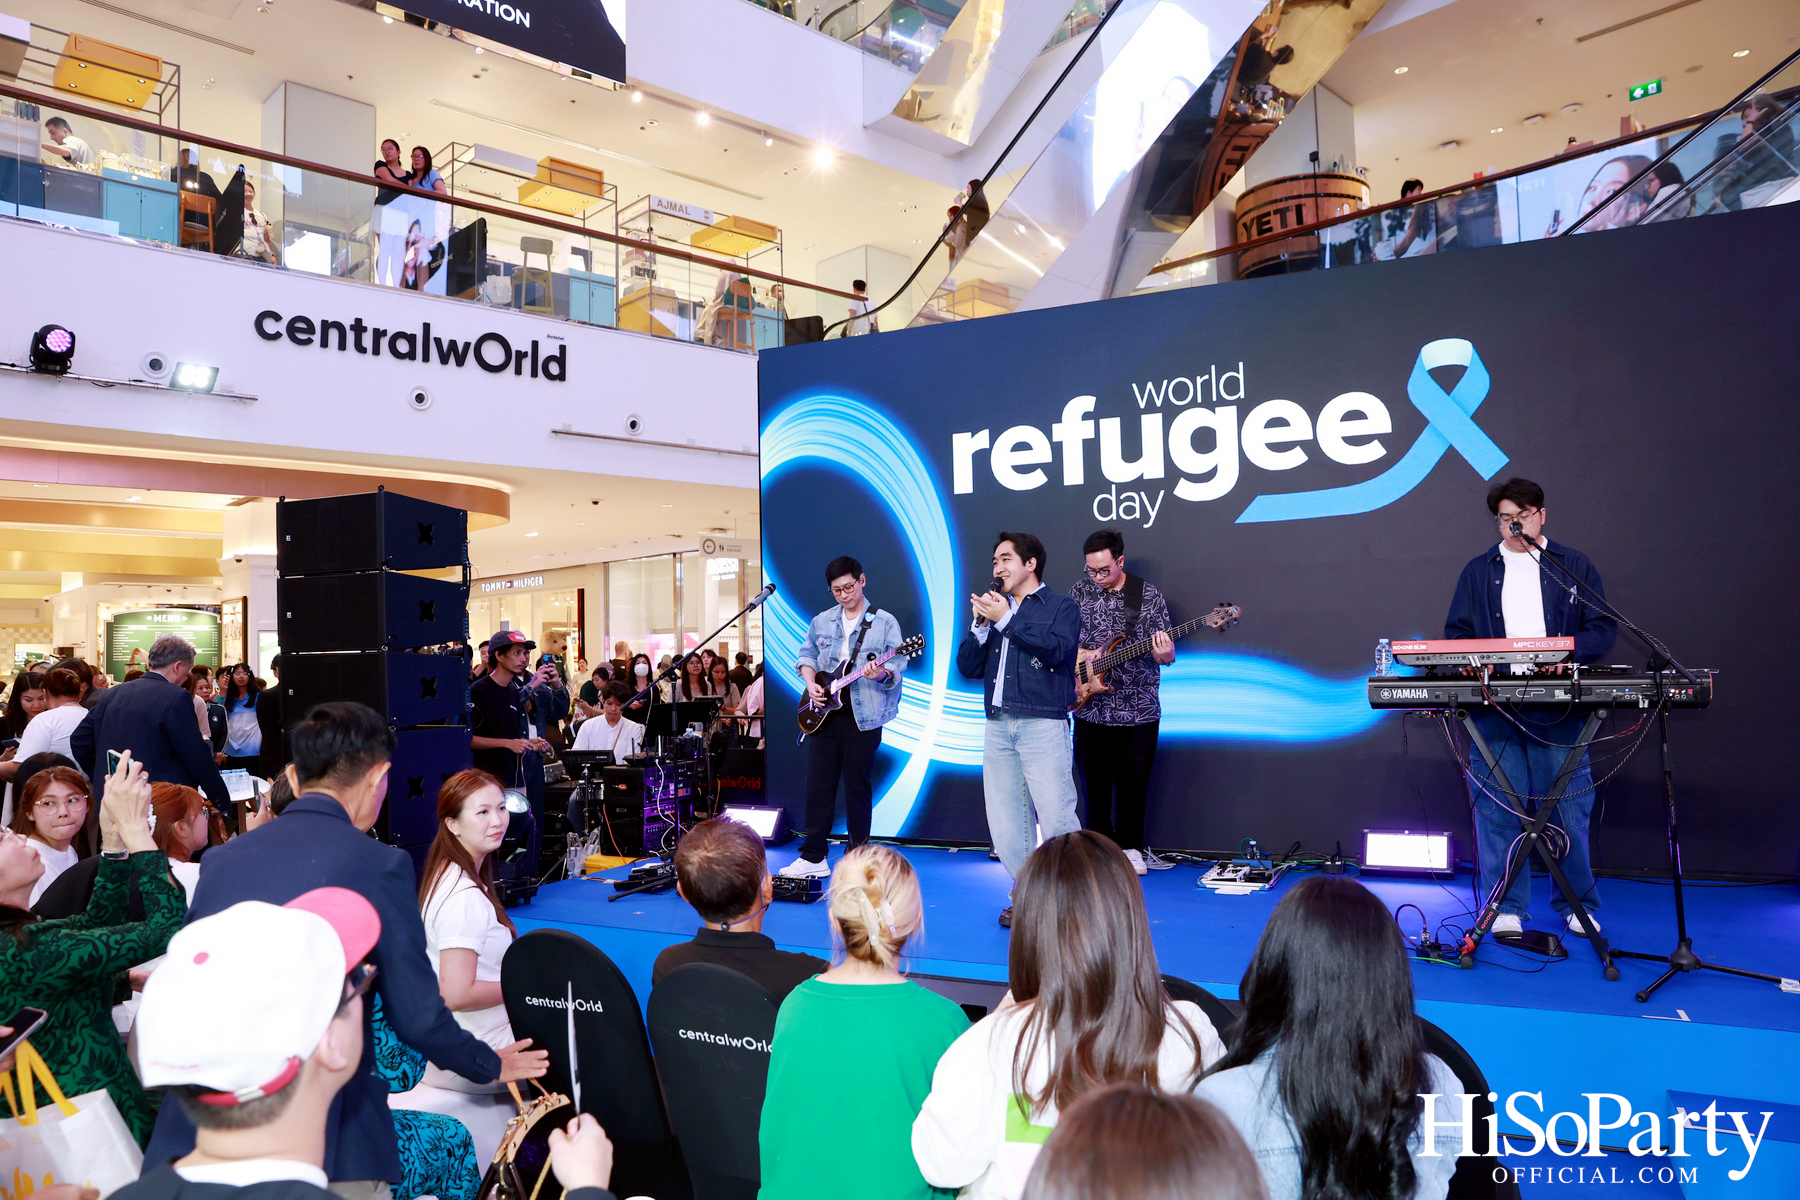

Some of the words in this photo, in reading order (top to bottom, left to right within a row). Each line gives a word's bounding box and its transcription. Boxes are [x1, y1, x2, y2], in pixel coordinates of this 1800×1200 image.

[657, 199, 691, 216] AJMAL
[1242, 204, 1304, 240] YETI
[254, 310, 567, 381] centralwOrld
[1132, 361, 1245, 409] world
[951, 391, 1393, 502] refugee
[1092, 484, 1165, 528] day
[481, 581, 506, 593] TOMMY
[513, 576, 544, 589] HILFIGER
[153, 614, 181, 623] MENU
[1556, 640, 1571, 648] 37
[1392, 688, 1429, 699] YAMAHA
